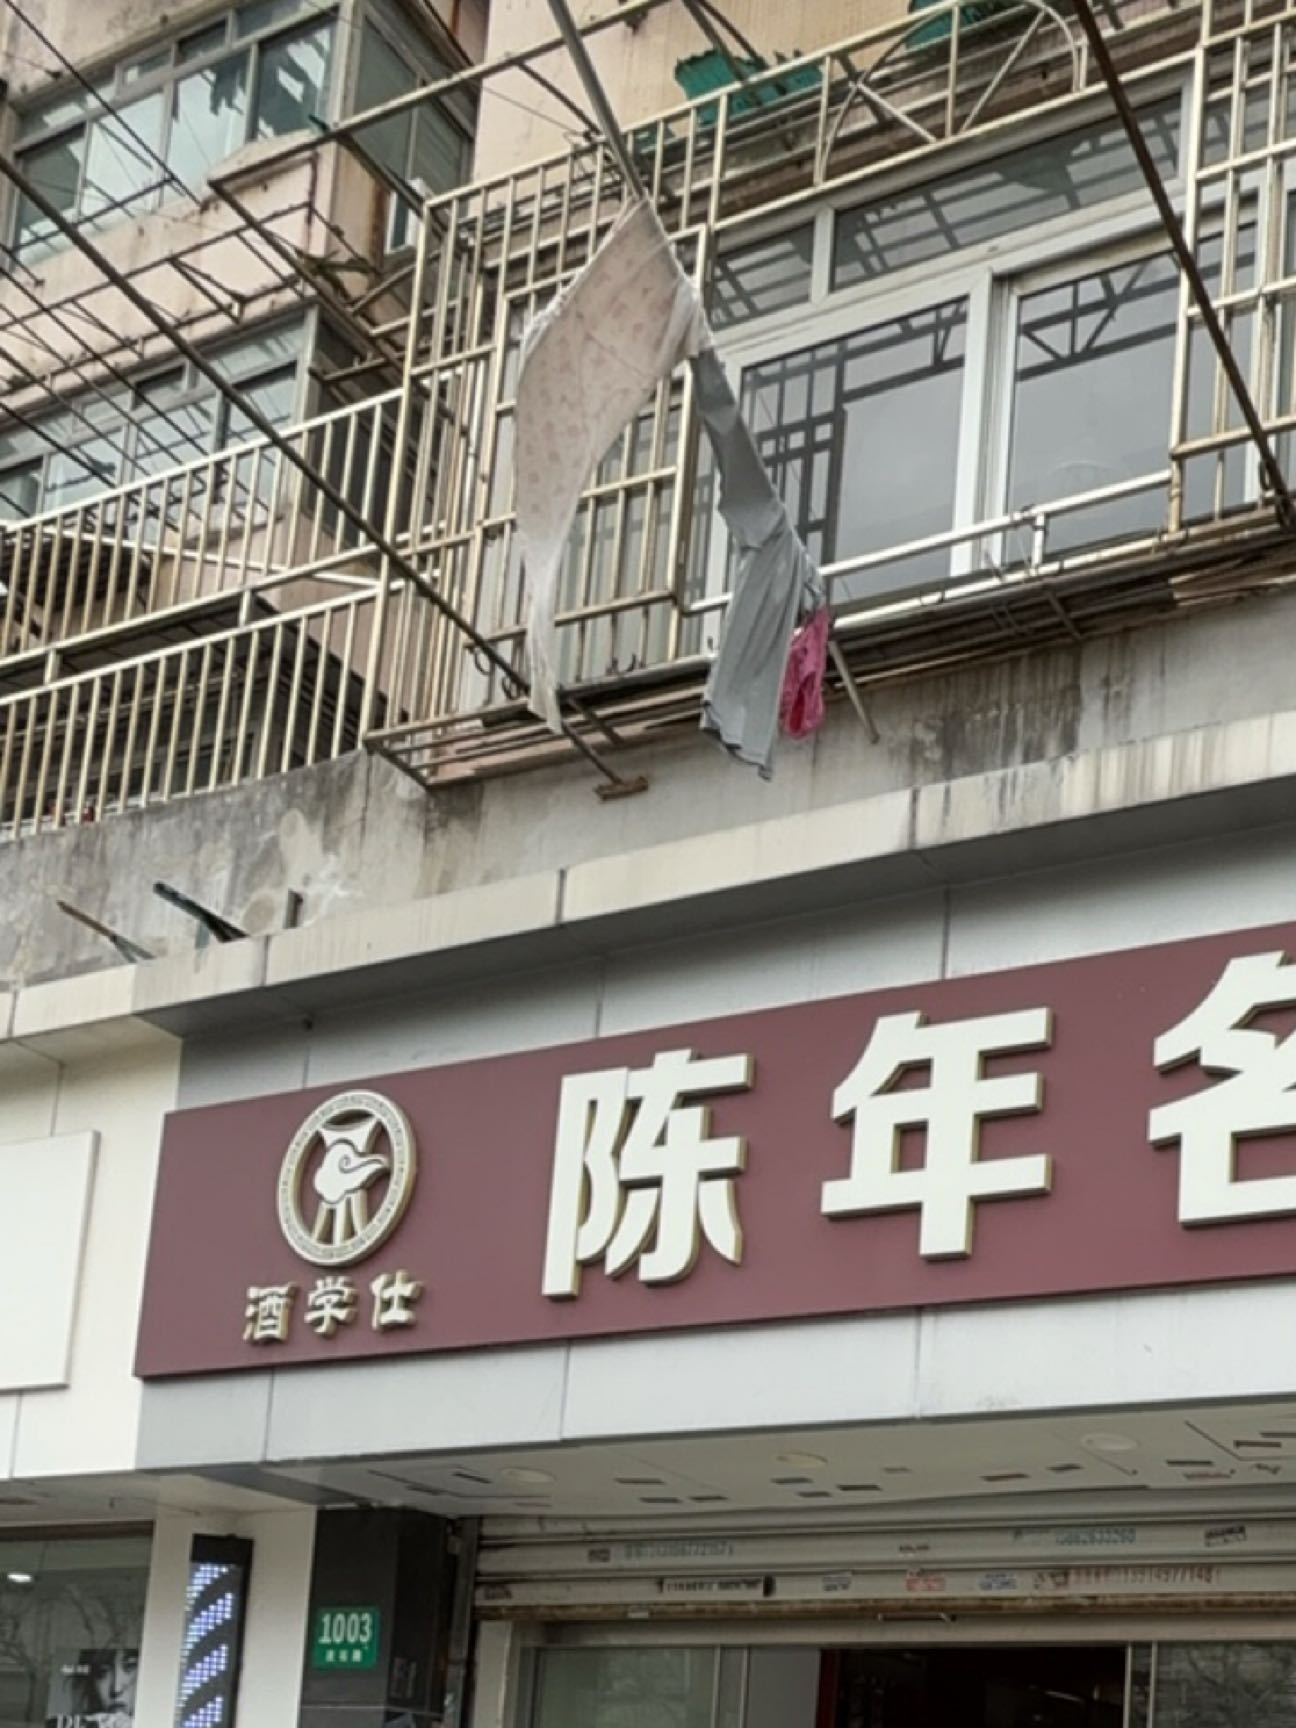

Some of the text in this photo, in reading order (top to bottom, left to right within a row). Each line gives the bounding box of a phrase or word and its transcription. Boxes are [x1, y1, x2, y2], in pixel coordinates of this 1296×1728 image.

[242, 1269, 423, 1343] 酒学仕
[318, 1612, 373, 1645] 1003
